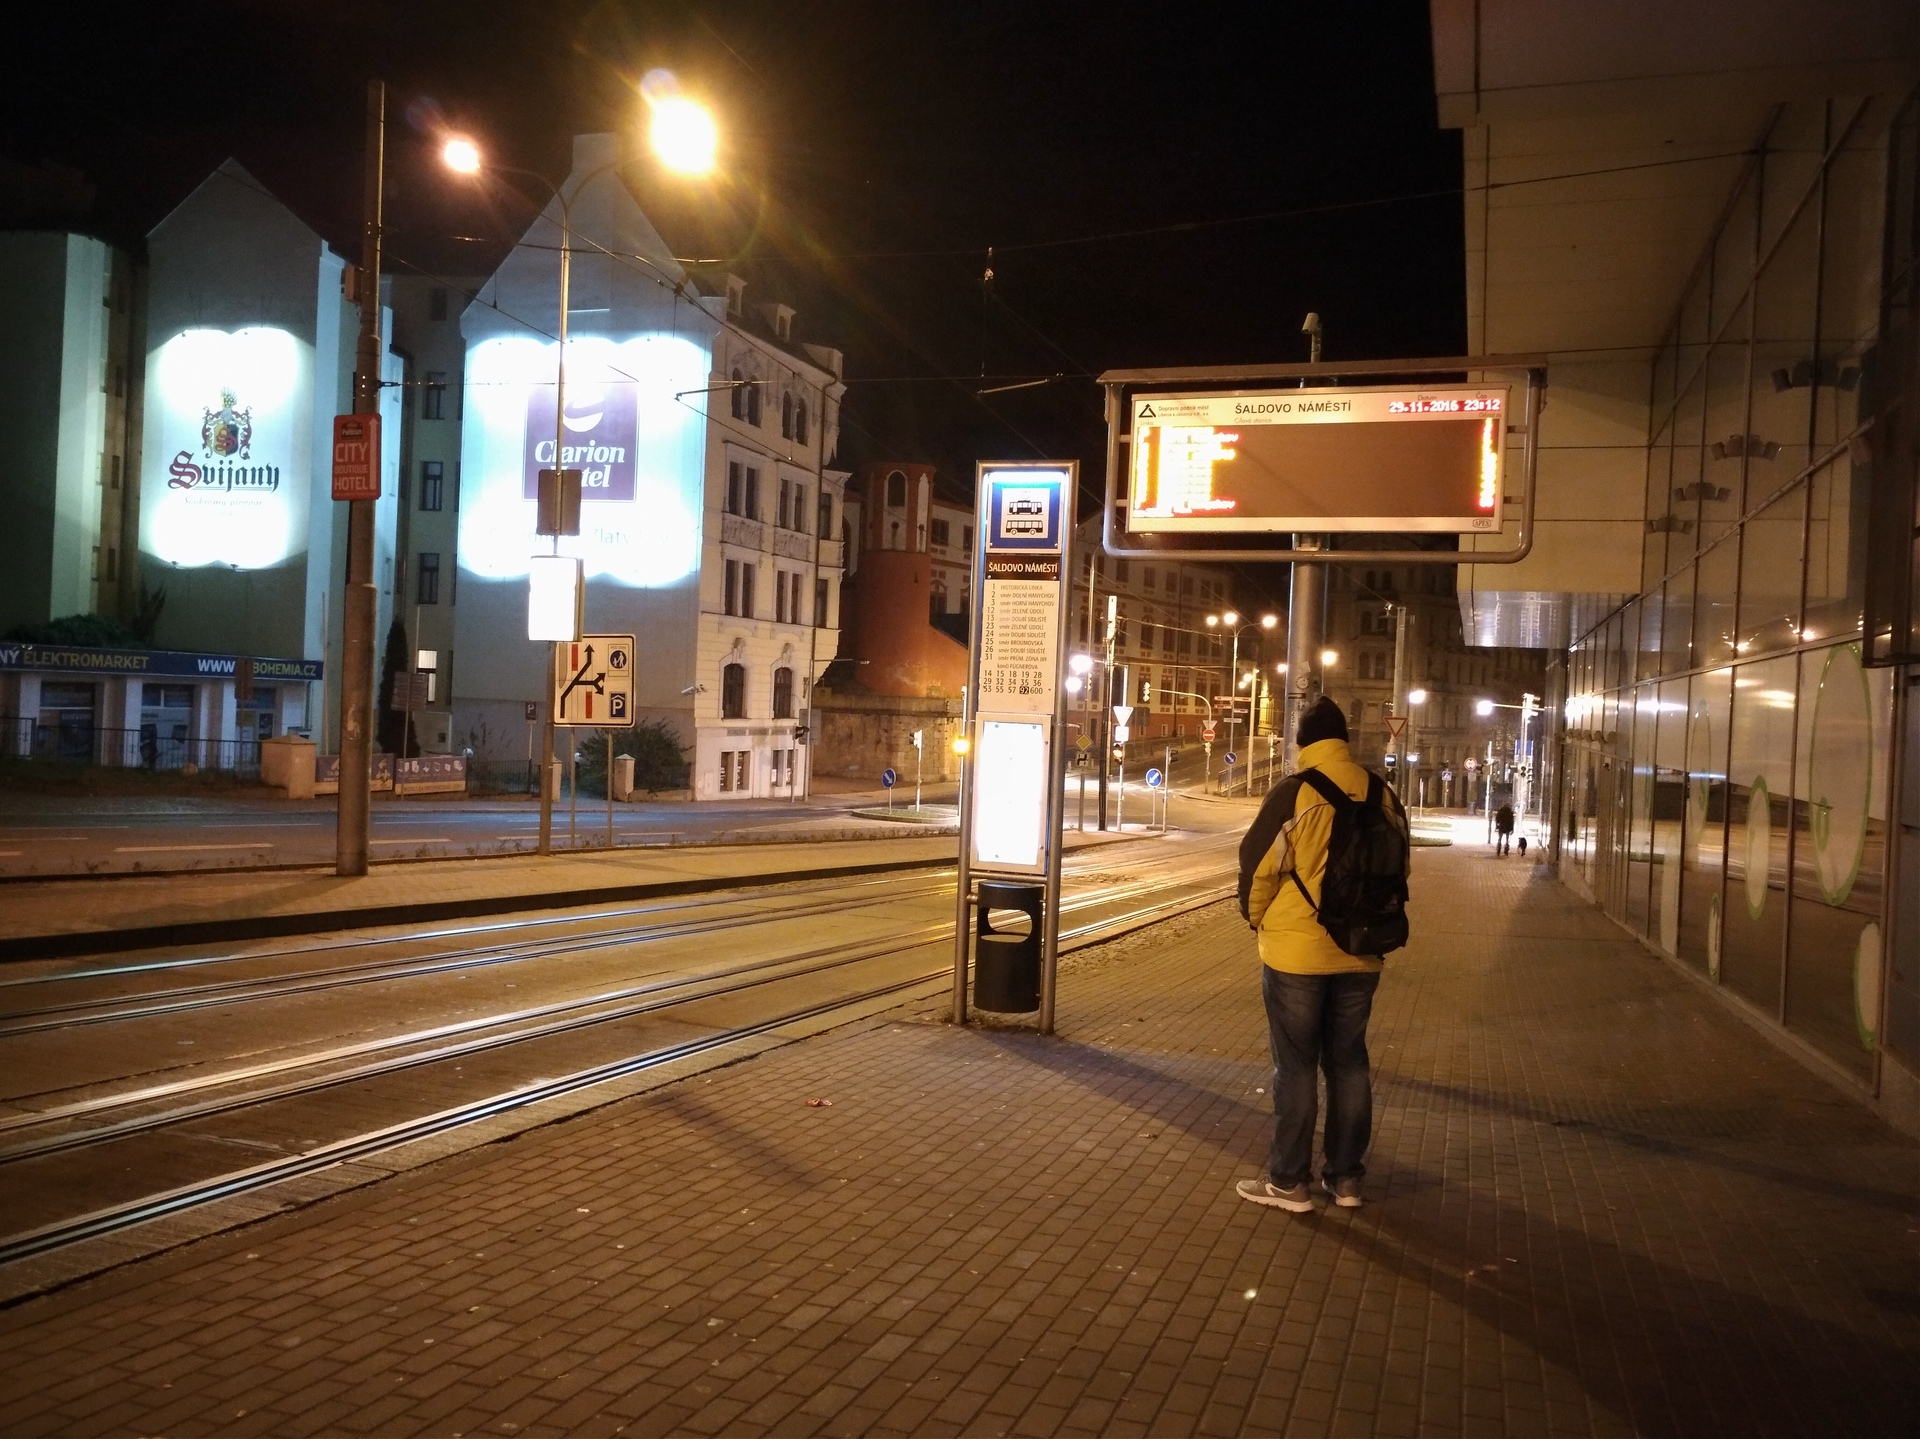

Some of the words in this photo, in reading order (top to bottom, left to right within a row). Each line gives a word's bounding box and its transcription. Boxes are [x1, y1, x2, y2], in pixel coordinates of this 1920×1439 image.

[1235, 403, 1292, 414] ŠALDOVO
[1298, 400, 1351, 412] NÁMĚSTÍ
[1389, 400, 1459, 413] 29.11.2016
[1464, 399, 1500, 410] 23:12
[335, 442, 368, 462] CITY
[535, 440, 625, 463] Clarion
[168, 450, 280, 493] Svijany
[334, 464, 368, 474] BOUTIQUE
[334, 476, 368, 490] HOTEL
[988, 562, 1023, 572] ŠALDOVO
[1025, 562, 1058, 572] NÁMĚSTÍ
[23, 651, 149, 669] ELEKTROMARKET
[528, 705, 534, 713] P
[613, 700, 623, 715] P
